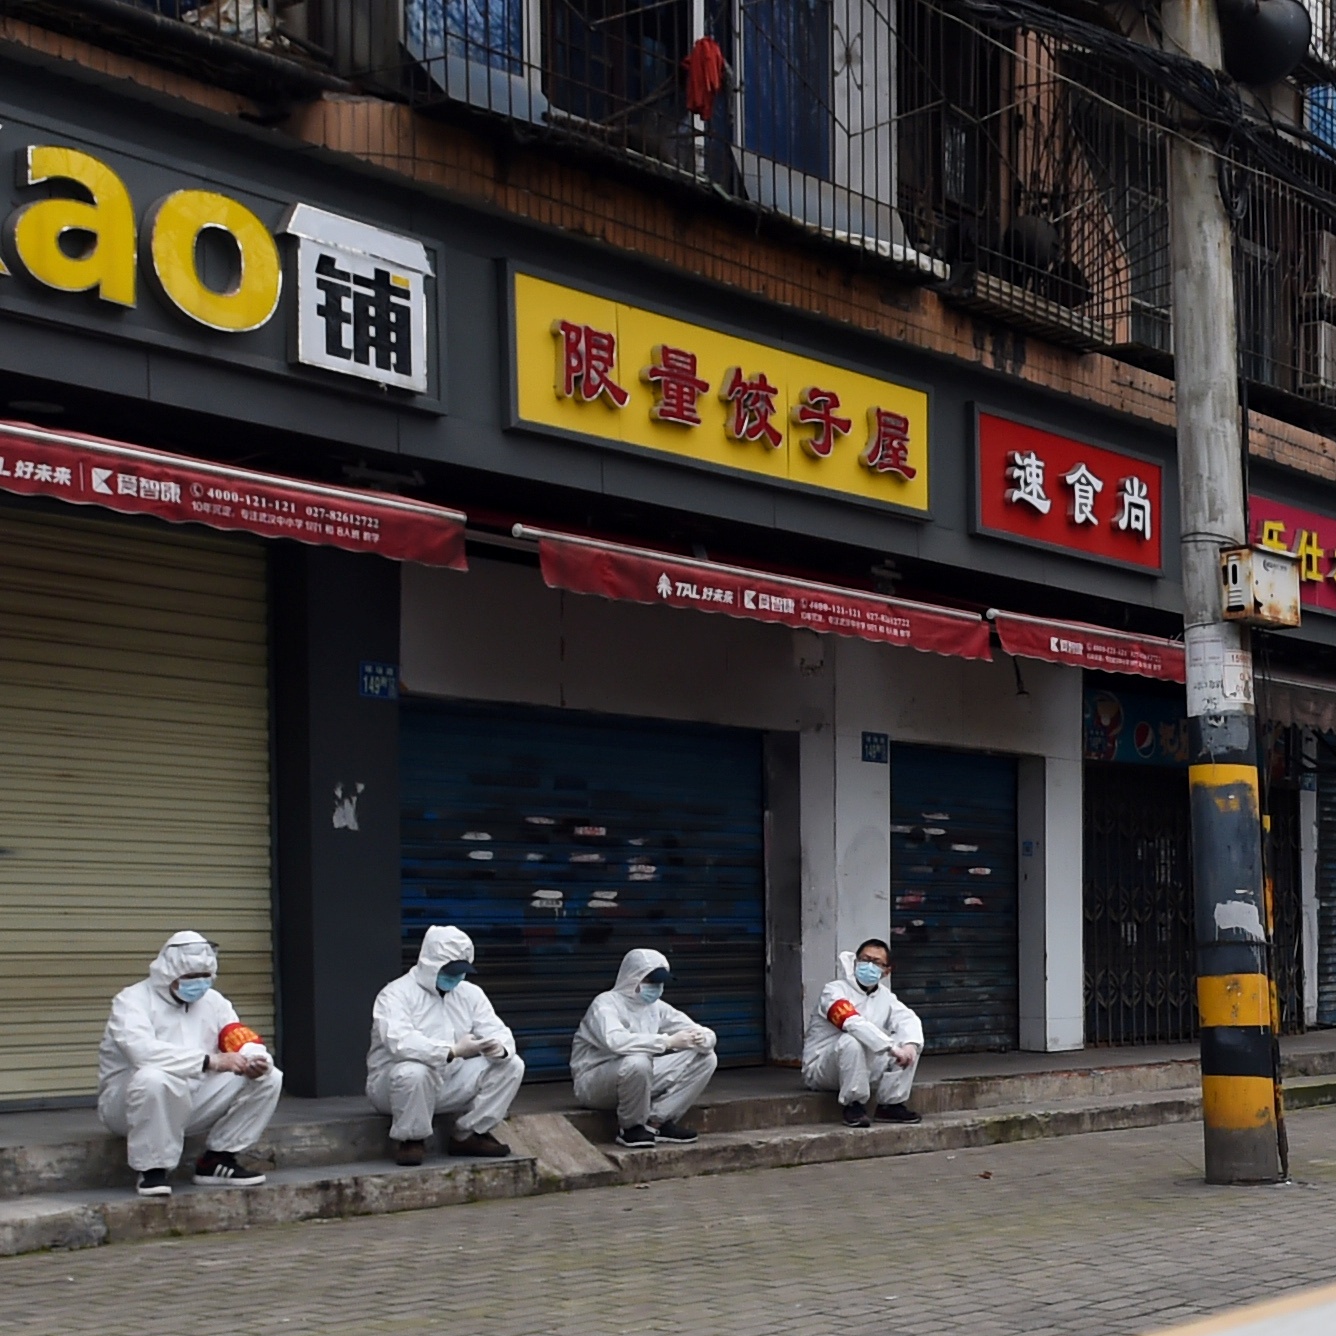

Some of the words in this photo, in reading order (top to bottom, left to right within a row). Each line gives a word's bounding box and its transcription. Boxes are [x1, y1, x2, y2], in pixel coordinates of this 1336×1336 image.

[0, 140, 283, 333] ao
[313, 253, 413, 378] 铺
[555, 318, 918, 482] 限量饺子屋
[14, 459, 72, 487] 好未来
[207, 487, 296, 513] 4000-121-121
[306, 506, 380, 529] 027-82612722
[1007, 450, 1152, 542] 速食尚
[675, 581, 701, 600] TAL
